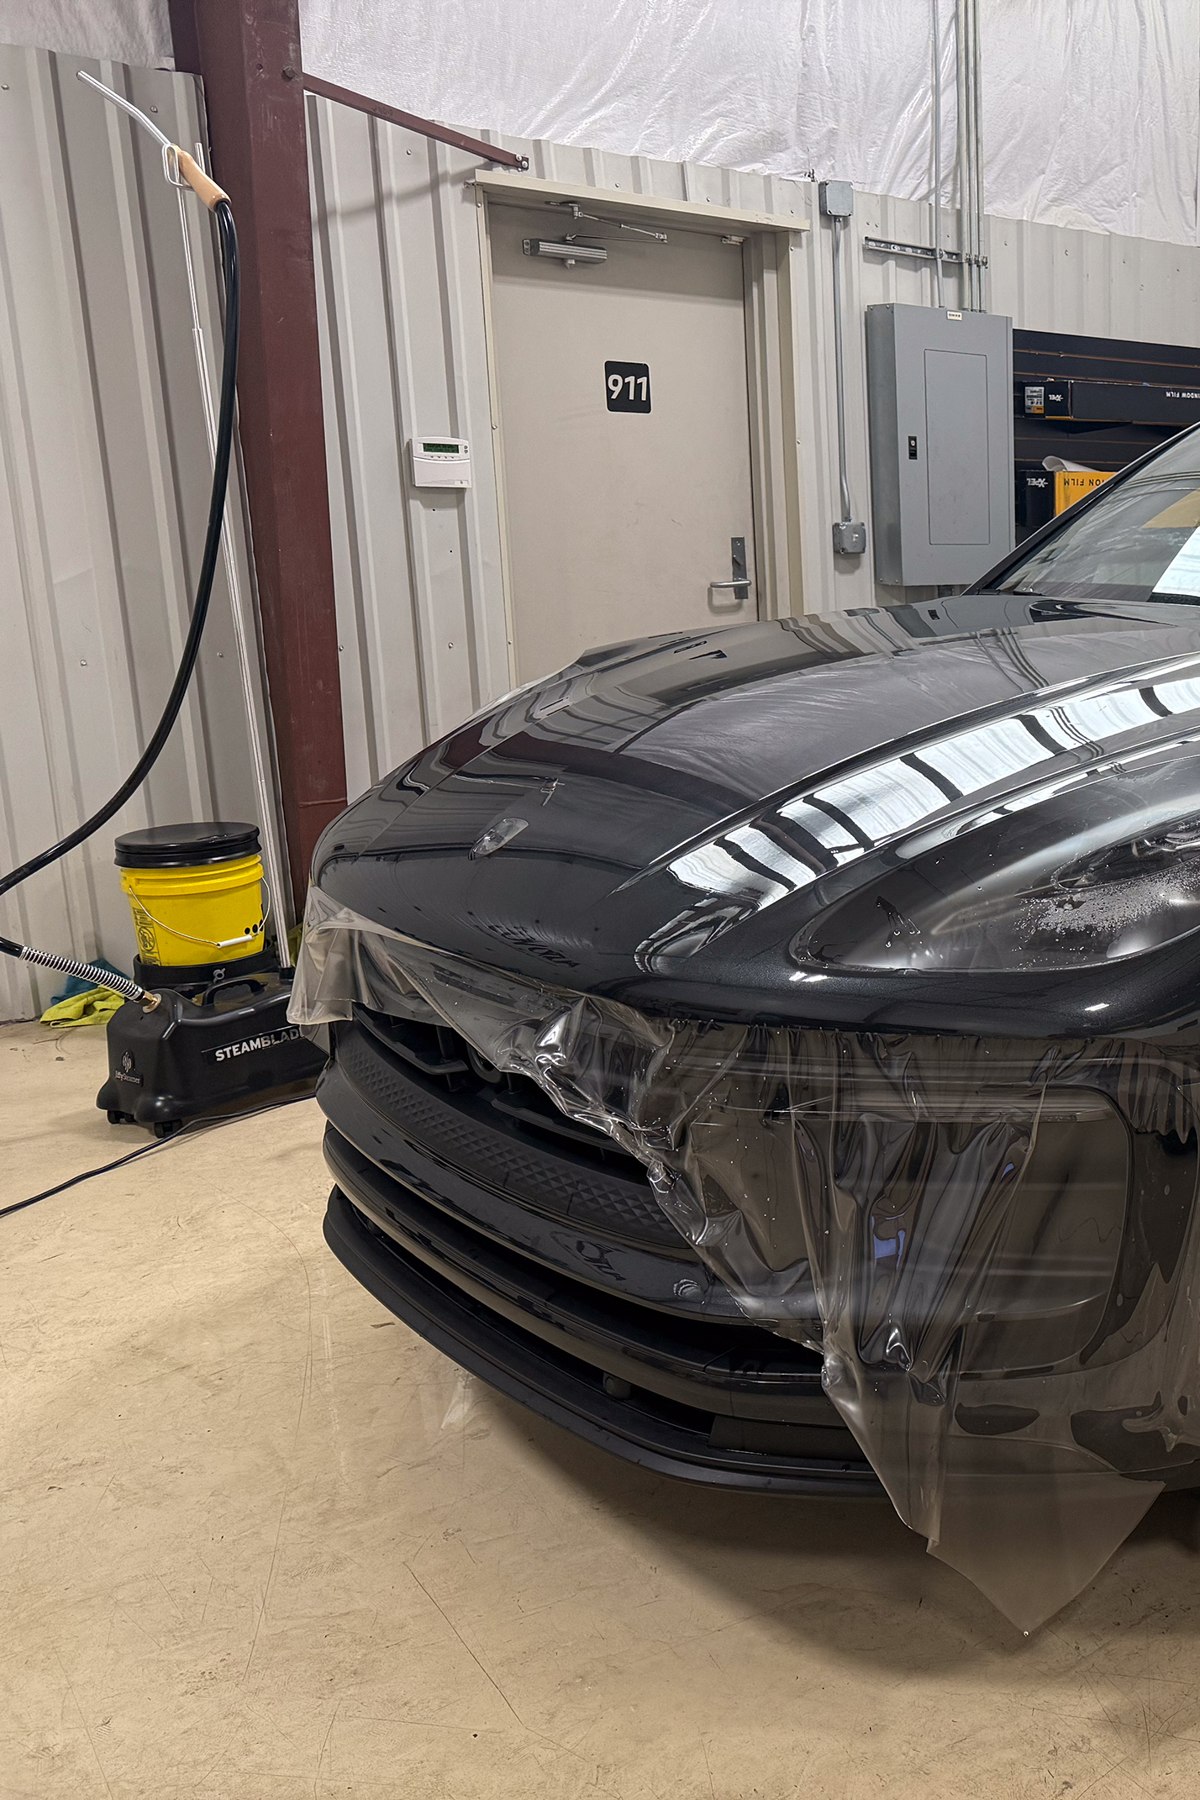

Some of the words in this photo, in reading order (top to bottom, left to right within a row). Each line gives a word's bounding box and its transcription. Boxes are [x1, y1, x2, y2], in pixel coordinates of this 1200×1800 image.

[607, 374, 648, 401] 911
[1026, 478, 1048, 488] XPEL
[1064, 478, 1085, 487] FILM
